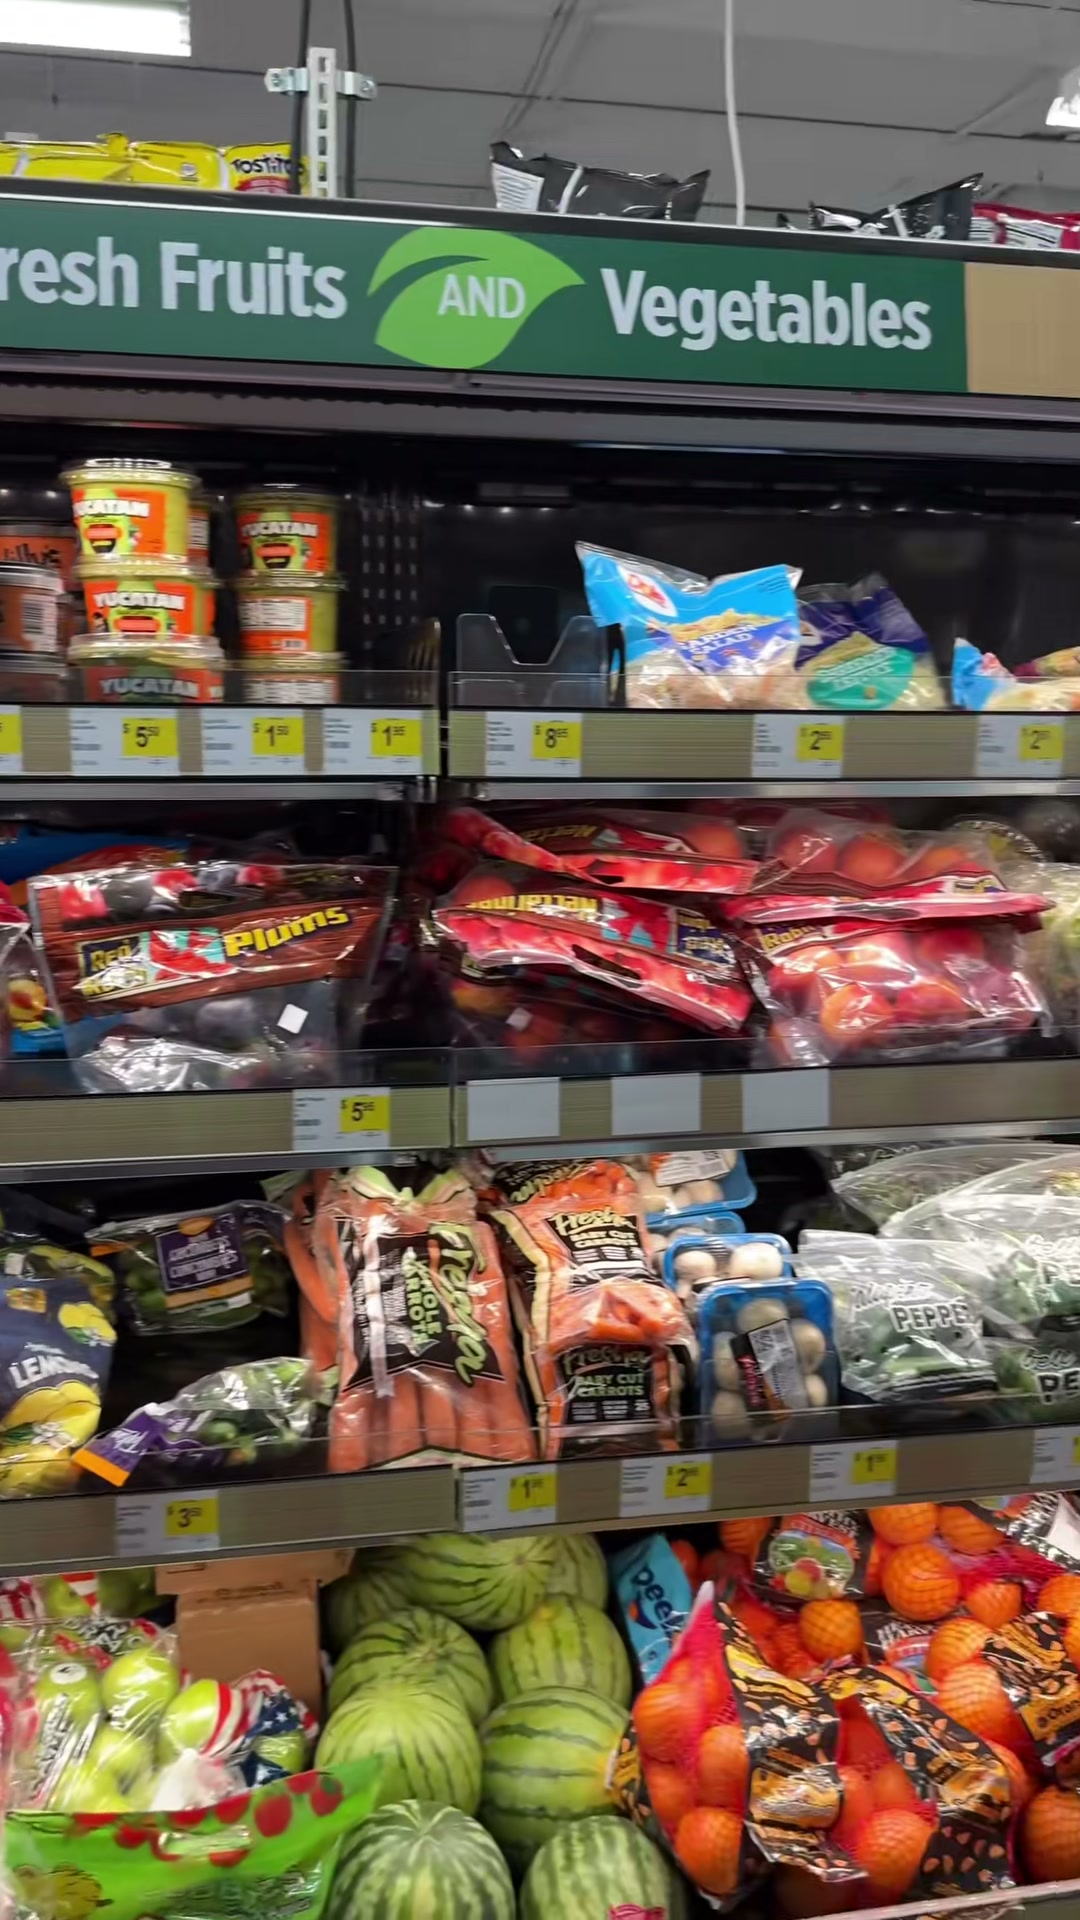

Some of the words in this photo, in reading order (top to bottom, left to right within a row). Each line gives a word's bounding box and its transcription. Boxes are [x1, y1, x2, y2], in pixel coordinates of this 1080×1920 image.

[161, 241, 347, 319] Fruits
[437, 273, 526, 318] AND
[601, 268, 932, 351] Vegetables
[222, 906, 350, 957] Plums
[577, 1385, 645, 1397] CARROTS
[616, 1373, 645, 1384] CUT
